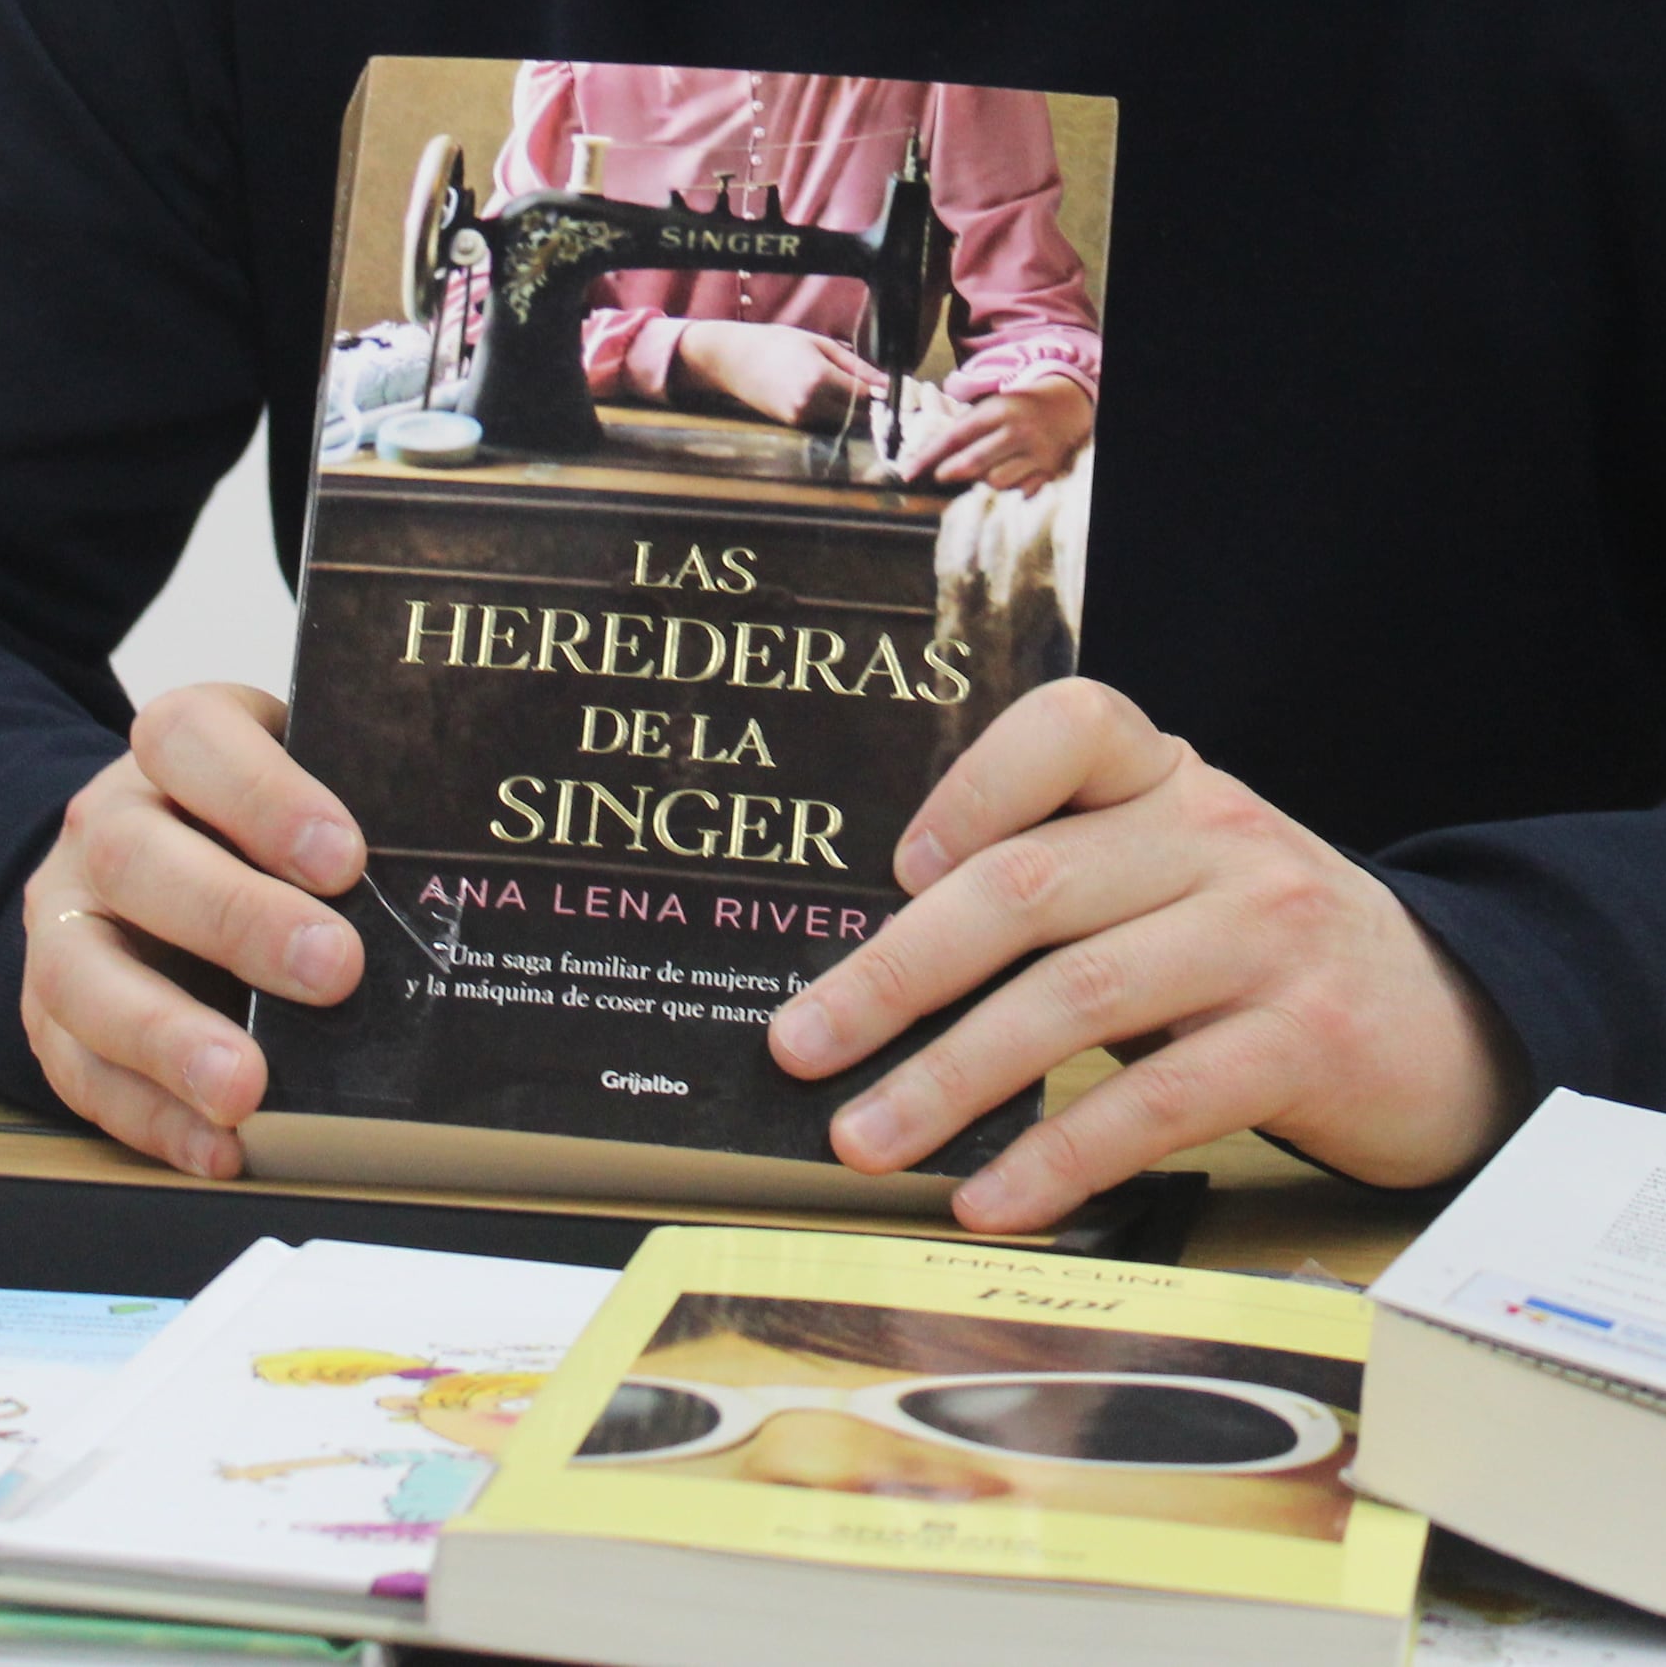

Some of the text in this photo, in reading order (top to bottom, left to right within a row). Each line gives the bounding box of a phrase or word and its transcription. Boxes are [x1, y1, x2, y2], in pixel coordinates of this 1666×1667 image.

[660, 225, 801, 258] SINGER
[631, 540, 758, 595] LAS
[398, 599, 972, 707] HEREDERAS
[579, 704, 777, 768] DE LA
[490, 775, 849, 870] SINGER
[419, 874, 526, 911] ANA
[554, 883, 687, 925] LENA
[448, 944, 495, 968] Una
[502, 952, 552, 975] saga
[560, 951, 651, 981] familiar
[657, 961, 683, 983] de
[691, 968, 780, 993] mujeres
[405, 980, 420, 998] y
[427, 974, 446, 997] la
[454, 977, 555, 1006] máquina
[562, 984, 590, 1008] de
[596, 995, 656, 1015] coser
[662, 1002, 704, 1022] que
[601, 1070, 689, 1097] Grijalbo
[924, 1253, 1185, 1289] EMMA CLINE
[977, 1286, 1126, 1313] Papi
